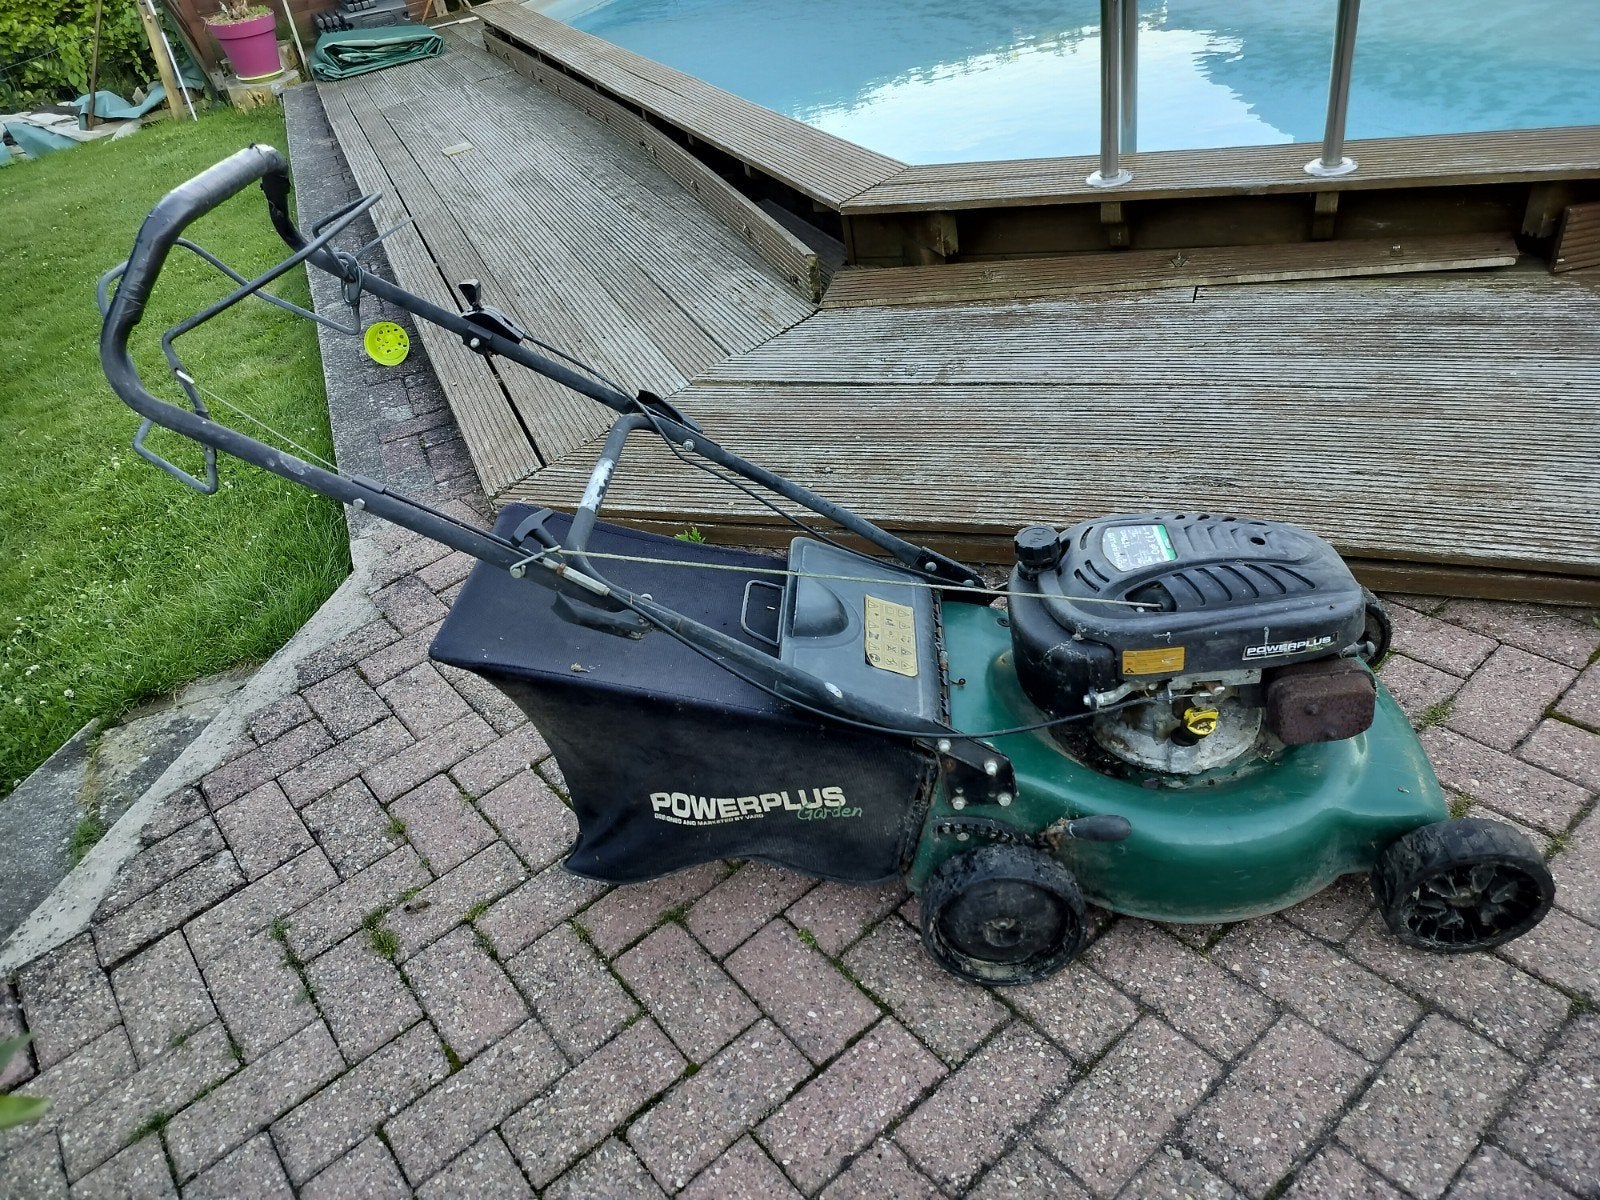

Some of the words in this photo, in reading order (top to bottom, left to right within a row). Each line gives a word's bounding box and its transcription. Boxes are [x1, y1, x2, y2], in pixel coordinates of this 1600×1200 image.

[1246, 636, 1332, 656] POWERPLUS
[649, 786, 847, 820] POWERPLUS
[797, 802, 863, 821] Garden
[697, 817, 734, 826] MARKETED
